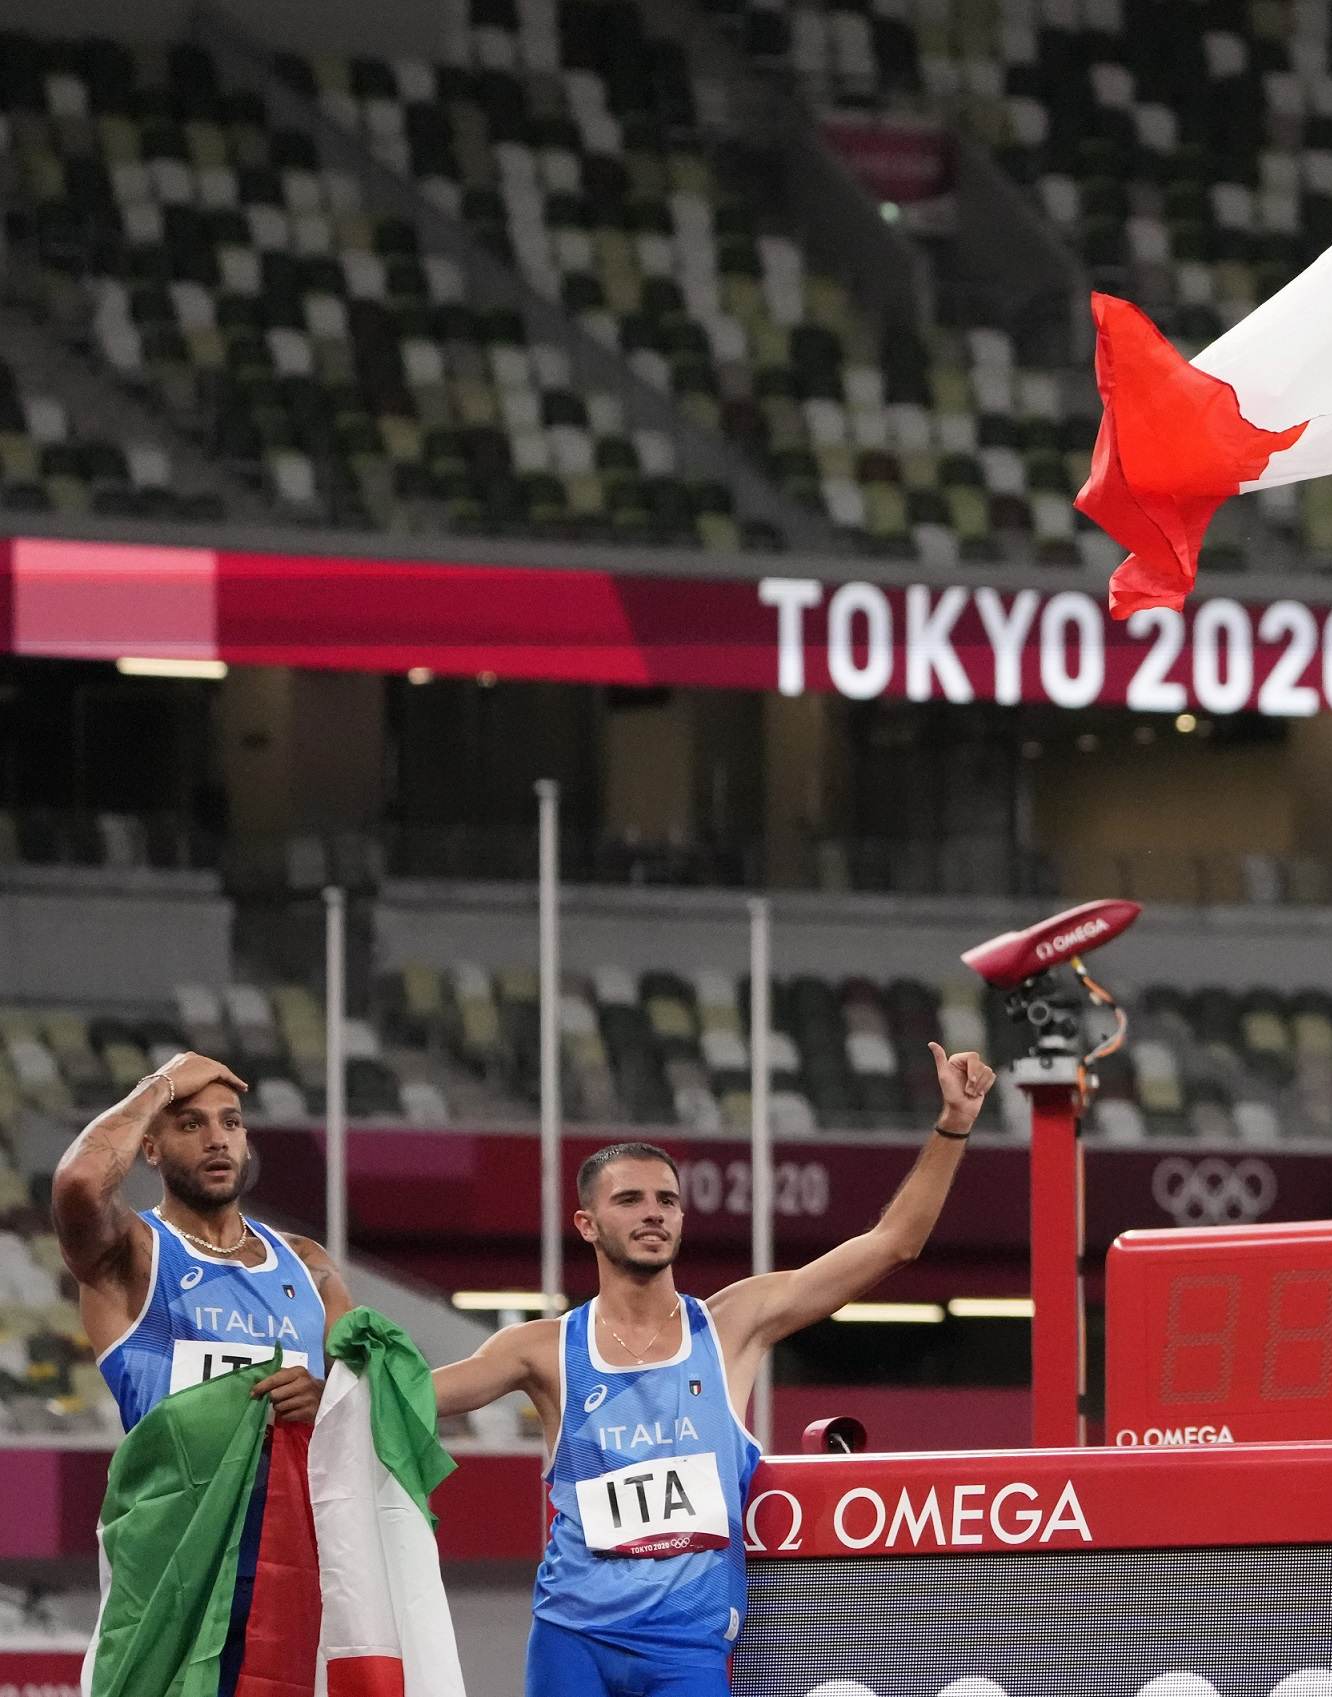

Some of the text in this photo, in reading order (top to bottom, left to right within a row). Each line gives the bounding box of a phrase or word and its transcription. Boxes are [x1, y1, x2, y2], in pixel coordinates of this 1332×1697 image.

[759, 577, 1105, 708] TOKYO
[1053, 917, 1110, 952] OMEGA
[194, 1306, 299, 1340] ITALIA
[202, 1353, 253, 1383] IT
[599, 1416, 699, 1451] ITALIA
[1143, 1425, 1234, 1447] OMEGA
[606, 1469, 697, 1529] ITA
[833, 1479, 1093, 1549] OMEGA
[631, 1544, 653, 1554] TOKYO
